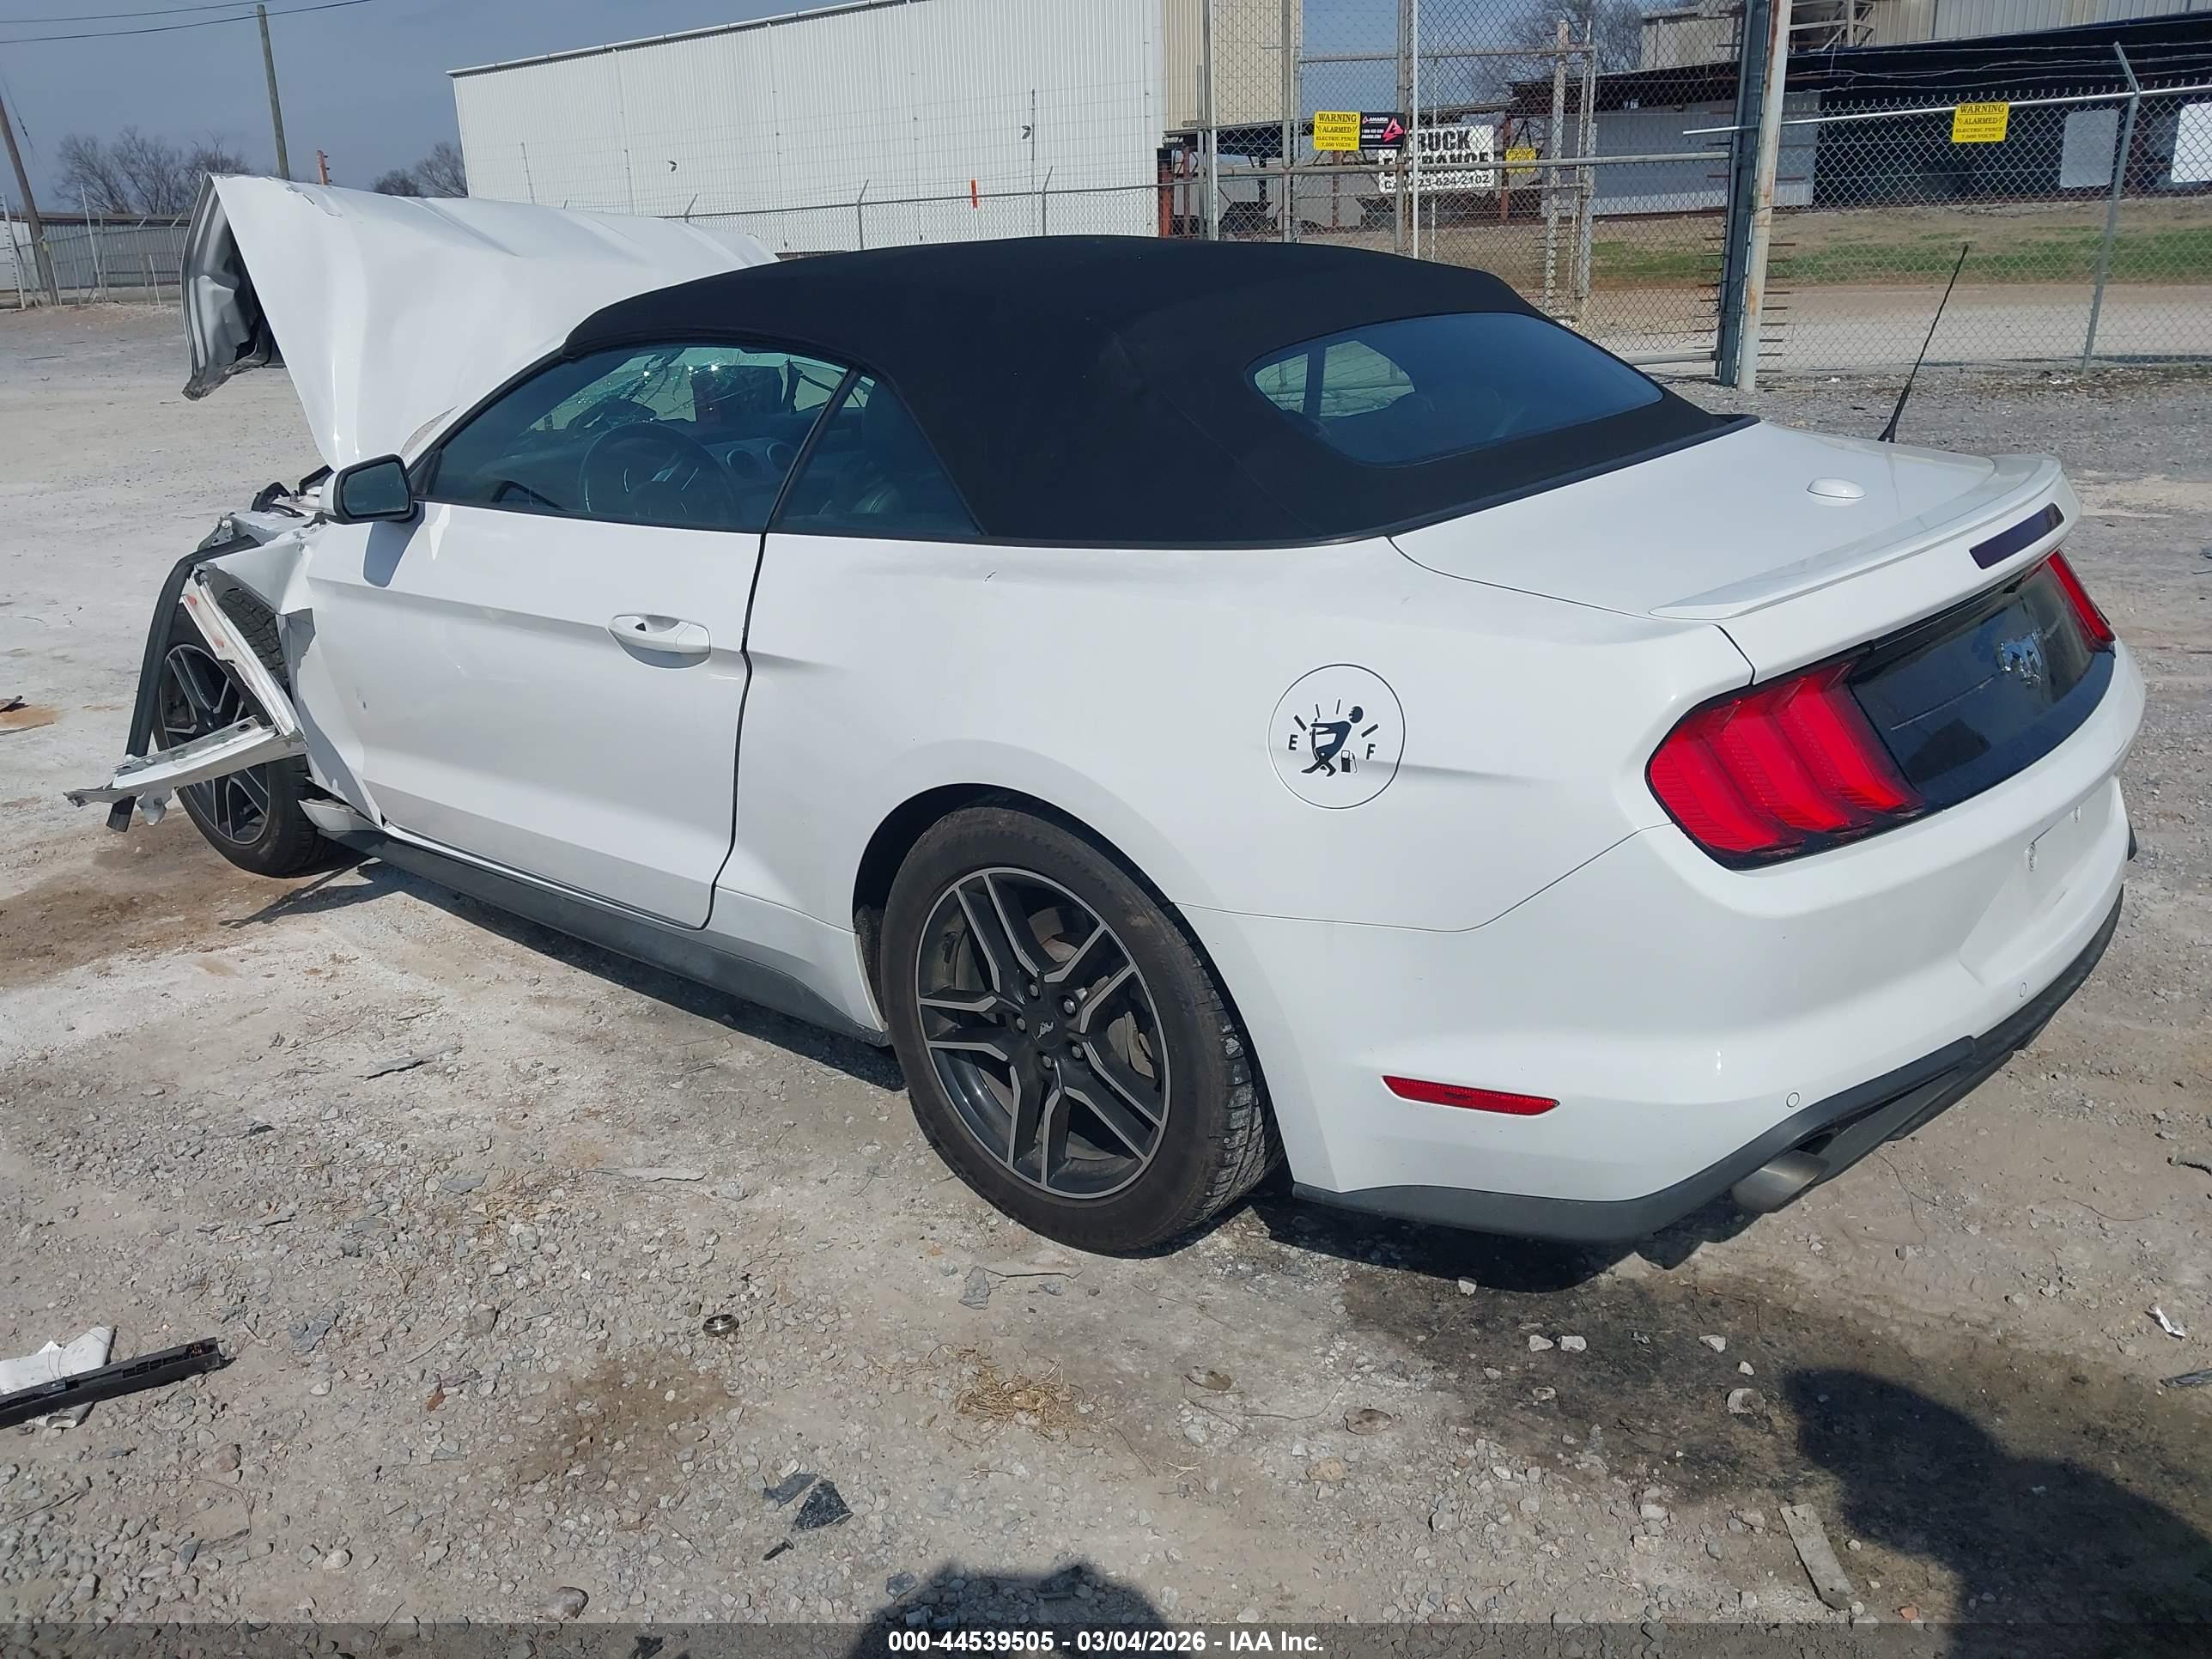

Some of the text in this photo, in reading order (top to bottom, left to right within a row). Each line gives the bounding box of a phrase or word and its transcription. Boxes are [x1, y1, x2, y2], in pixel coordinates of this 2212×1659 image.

[1960, 104, 2005, 113] WARNING
[1318, 113, 1357, 123] WARNING
[1964, 117, 1998, 125] ALARMED
[1322, 125, 1352, 134] ALARMED
[1418, 130, 1471, 152] RUCK
[1288, 734, 1298, 751] E
[1365, 744, 1376, 760] F
